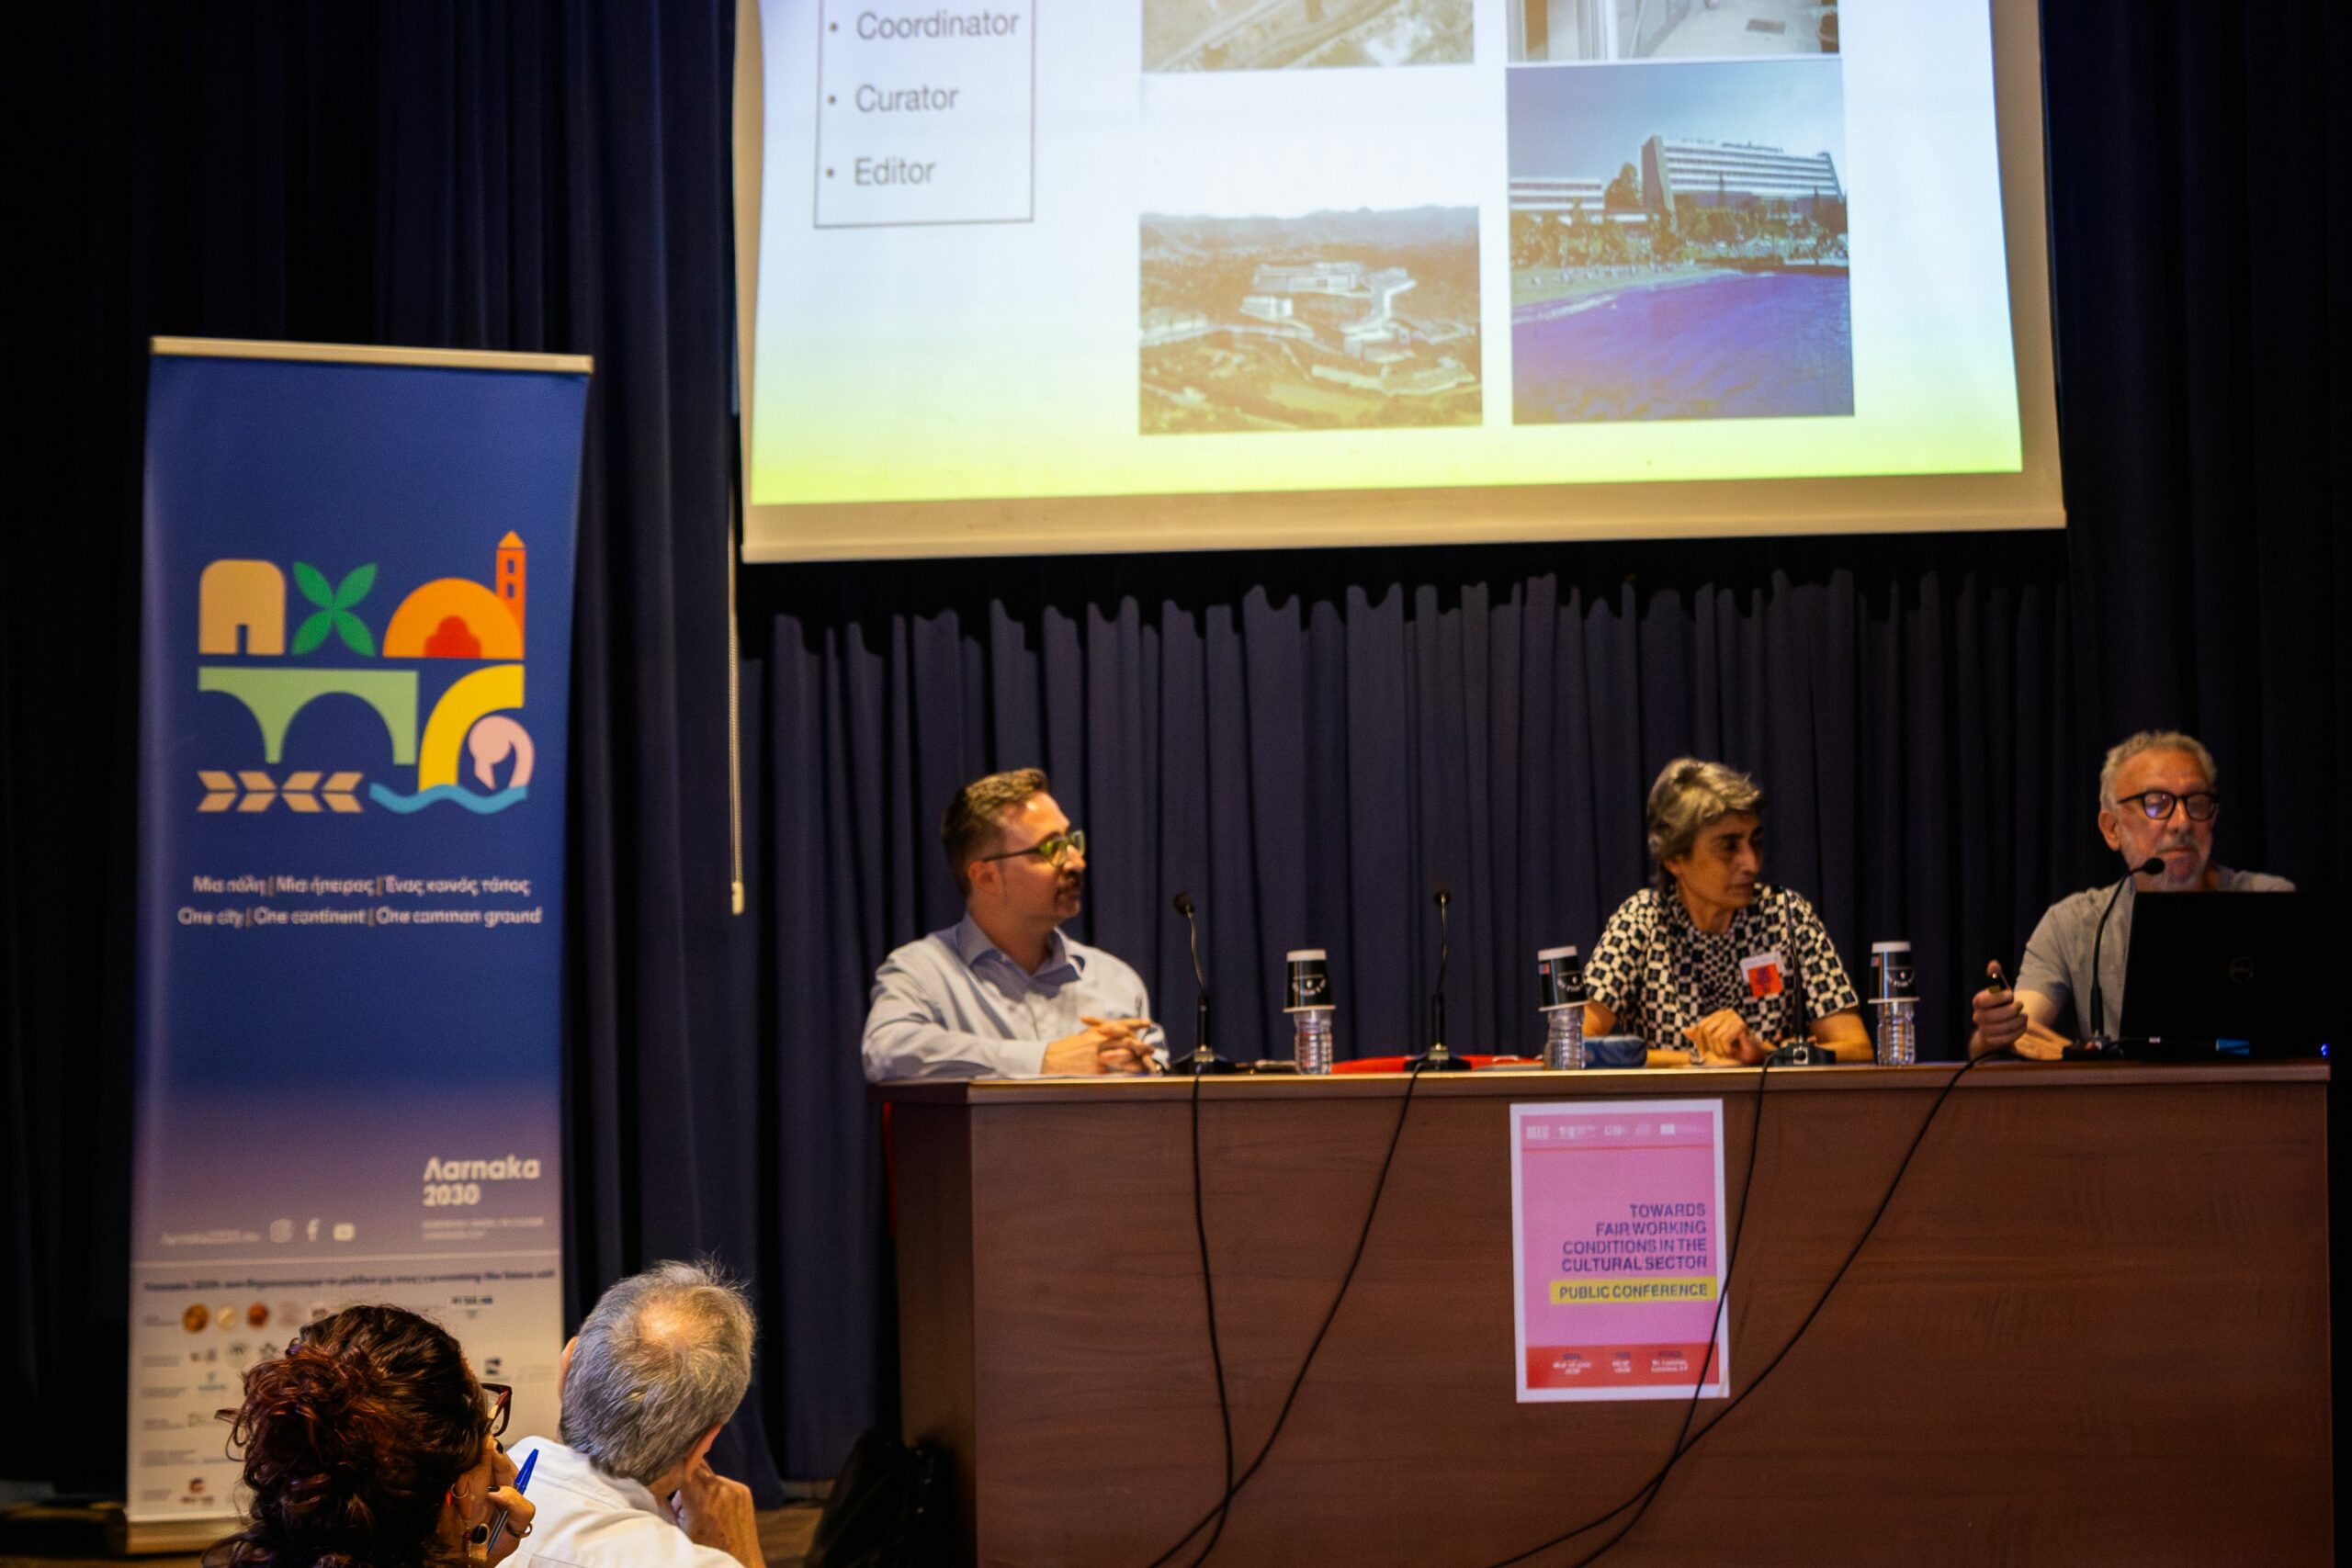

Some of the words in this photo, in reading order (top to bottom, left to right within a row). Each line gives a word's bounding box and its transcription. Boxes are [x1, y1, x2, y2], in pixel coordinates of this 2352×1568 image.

[856, 10, 1020, 40] Coordinator
[855, 84, 959, 113] Curator
[854, 156, 935, 186] Editor
[177, 906, 214, 925] One
[217, 908, 243, 929] city
[254, 906, 288, 925] One
[290, 907, 368, 925] continent
[376, 906, 411, 925] One
[413, 909, 482, 924] common
[484, 906, 543, 928] ground
[423, 1181, 481, 1207] 2030
[1630, 1202, 1706, 1218] TOWARDS
[1595, 1222, 1629, 1236] FAIR
[1632, 1220, 1707, 1235] WORKING
[1562, 1240, 1657, 1255] CONDITIONS
[1659, 1239, 1674, 1253] IN
[1678, 1237, 1707, 1252] THE
[1561, 1257, 1643, 1272] CULTURAL
[1645, 1255, 1707, 1270] SECTOR
[1559, 1285, 1610, 1300] PUBLIC
[1612, 1282, 1708, 1298] CONFERENCE
